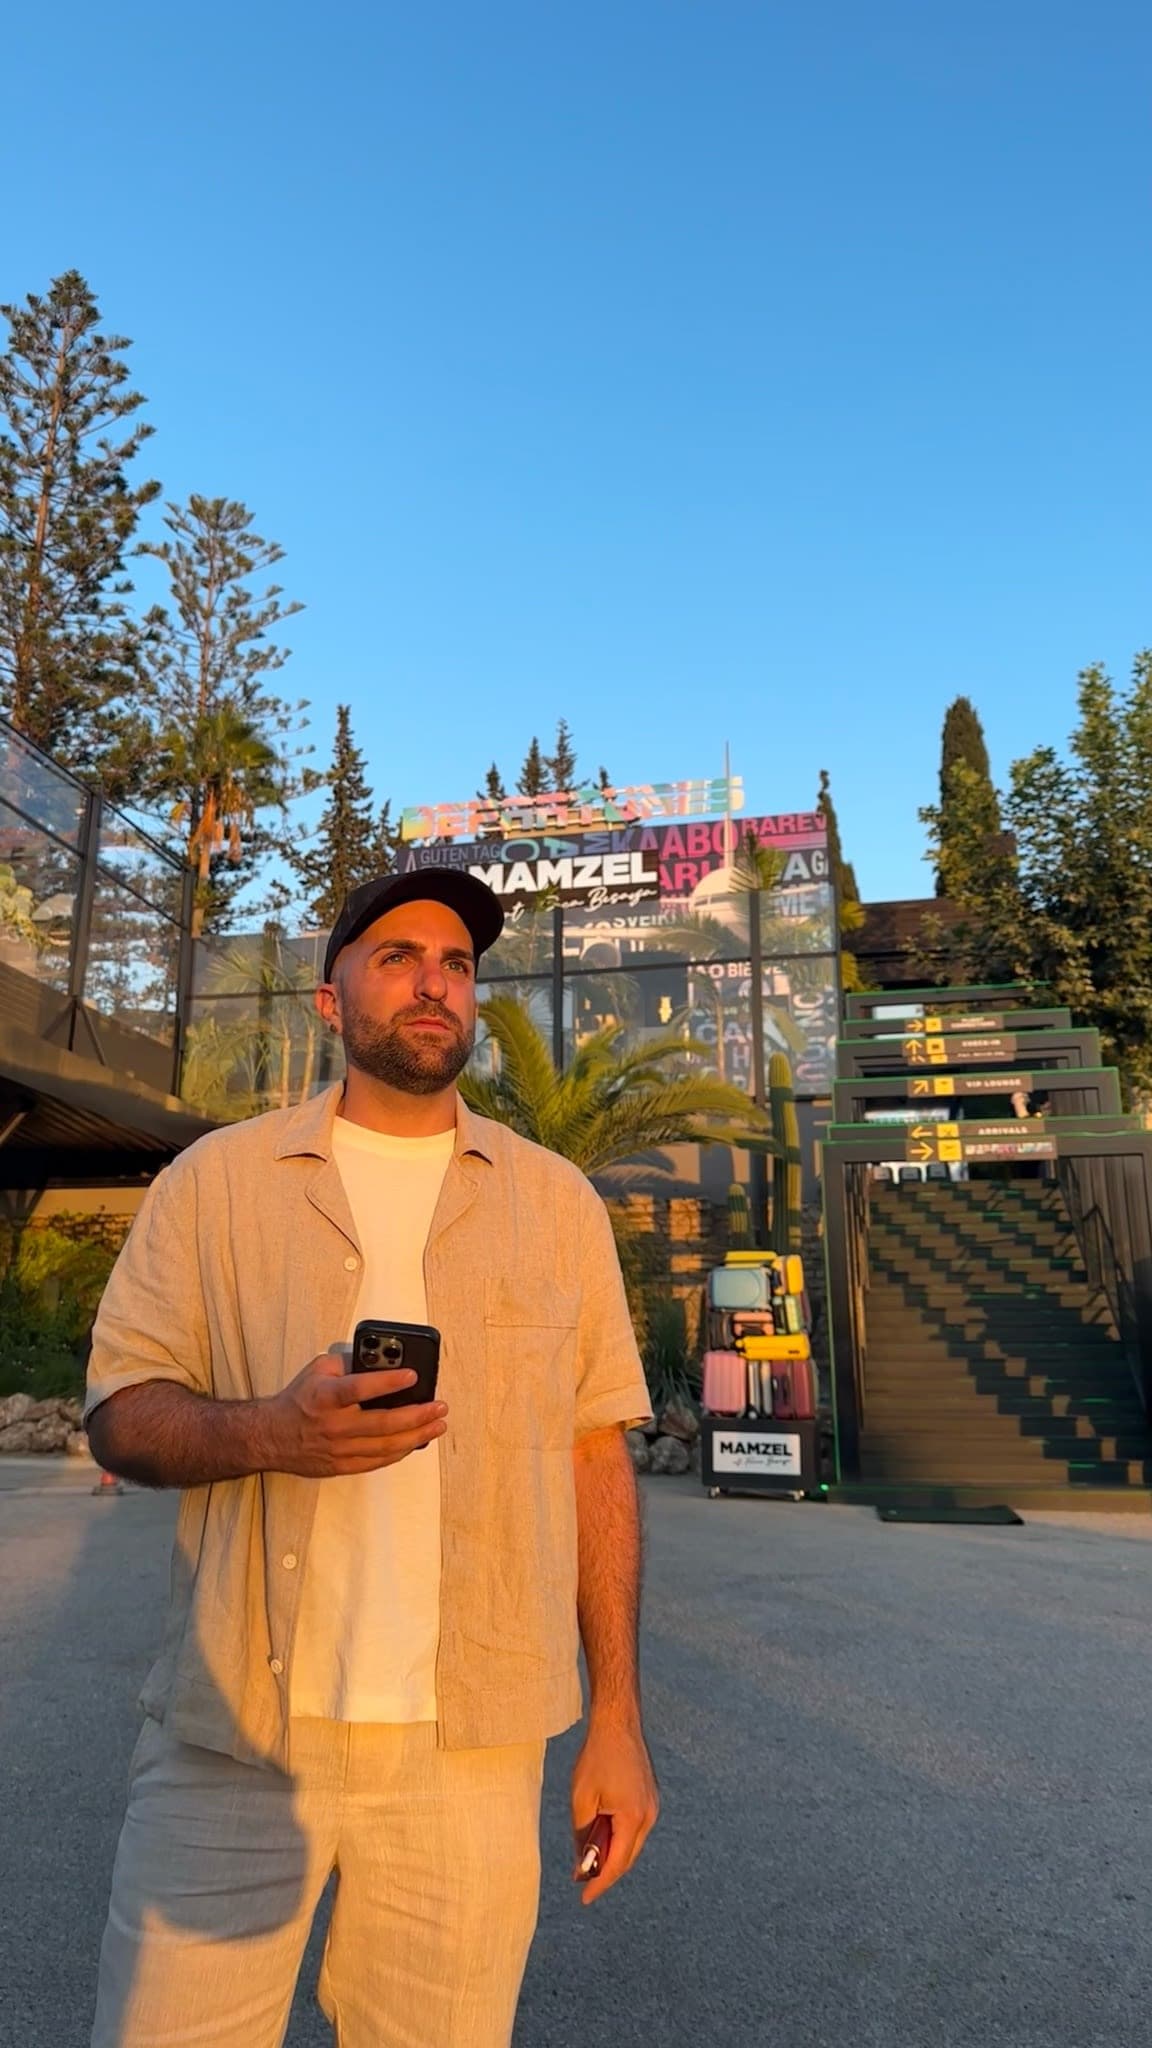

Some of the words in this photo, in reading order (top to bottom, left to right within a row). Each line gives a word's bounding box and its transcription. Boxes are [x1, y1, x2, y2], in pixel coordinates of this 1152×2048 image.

[420, 847, 468, 865] GUTEN
[471, 844, 501, 860] TAG
[469, 852, 658, 895] MAMZEL
[965, 1080, 982, 1088] VIP
[978, 1126, 1028, 1135] ARRIVALS
[720, 1441, 793, 1457] MAMZEL
